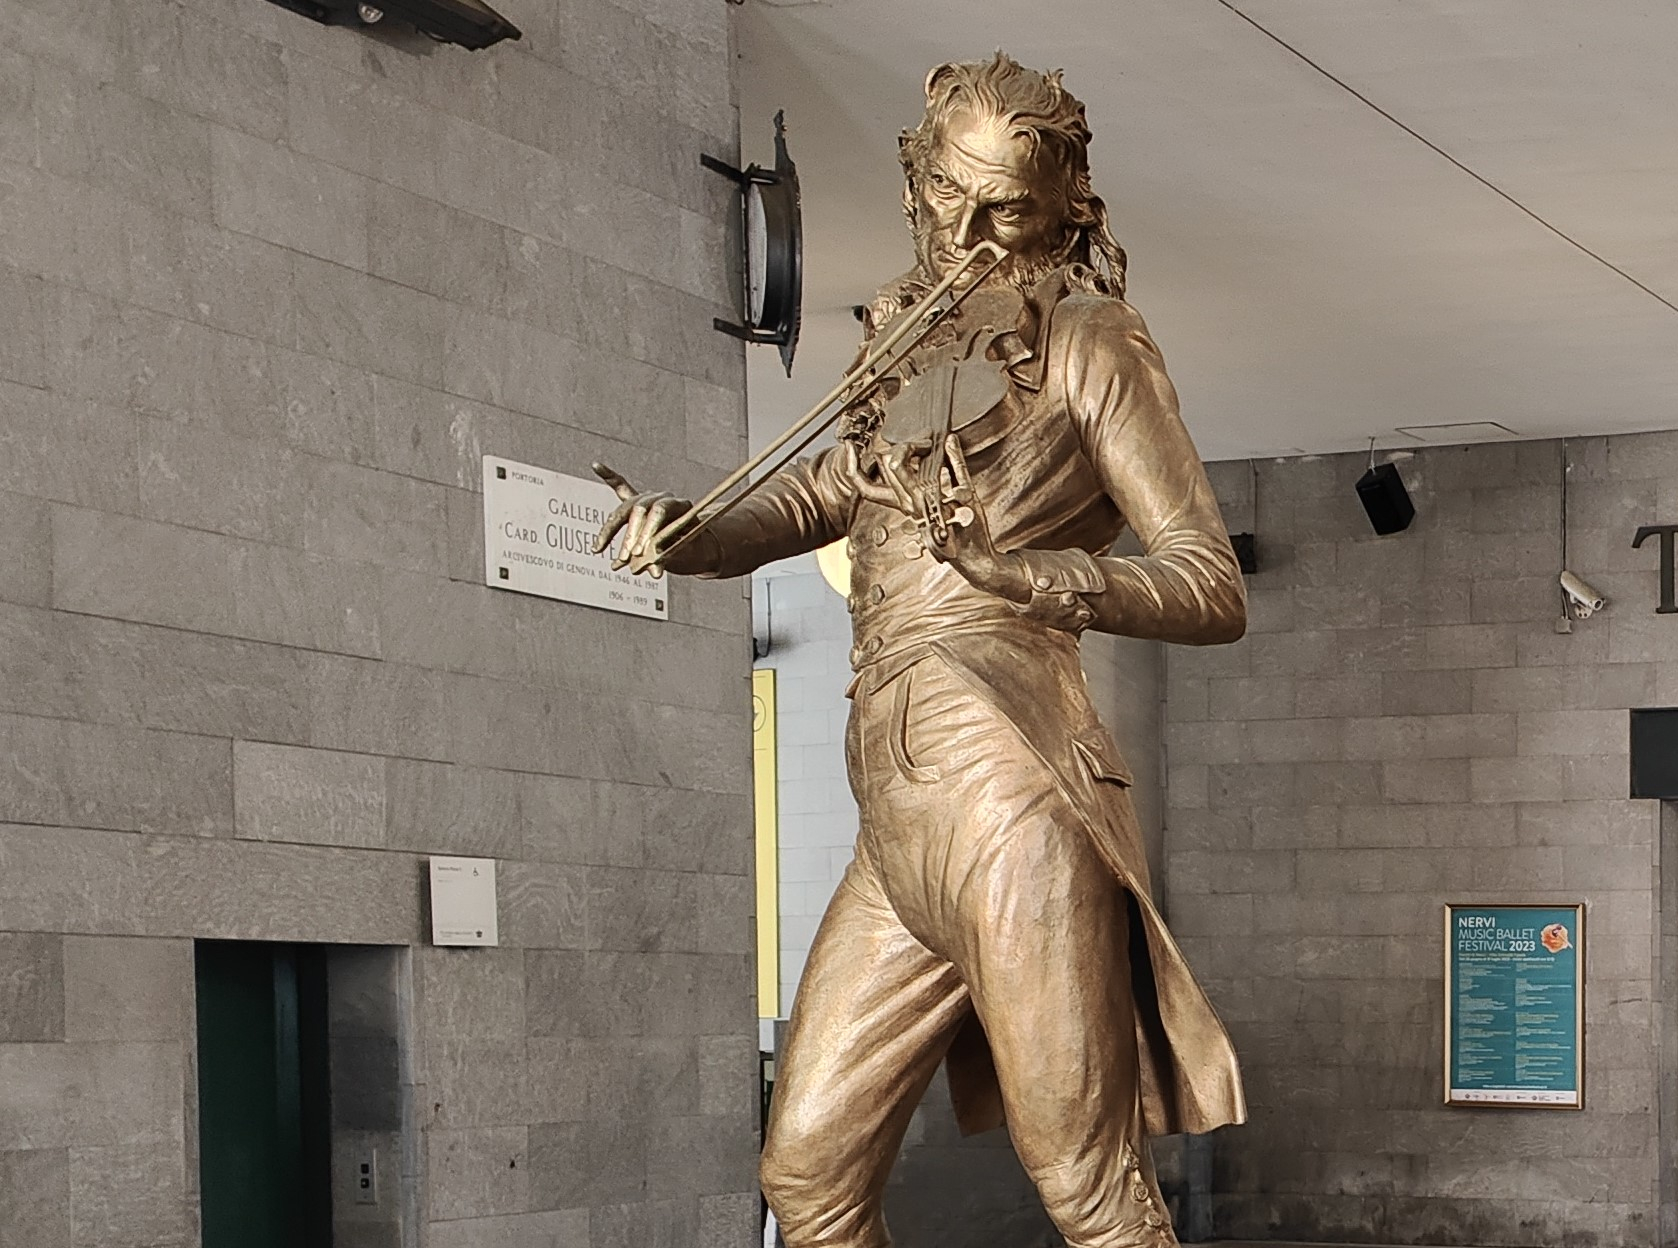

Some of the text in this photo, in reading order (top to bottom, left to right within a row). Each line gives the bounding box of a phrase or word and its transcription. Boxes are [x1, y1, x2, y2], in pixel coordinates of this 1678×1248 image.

[548, 497, 609, 526] GALLERI
[546, 523, 618, 561] GIUSEPE
[502, 549, 554, 570] ARCIVESCOVO
[556, 560, 564, 571] DI
[567, 562, 595, 578] GENOVA
[598, 569, 612, 581] DAL
[615, 573, 630, 585] 1946
[633, 578, 643, 588] AL
[609, 590, 624, 601] 1906
[1458, 916, 1496, 928] NERVI
[1458, 928, 1534, 939] MUSIC BALLET
[1458, 940, 1536, 952] FESTIVAL 2023
